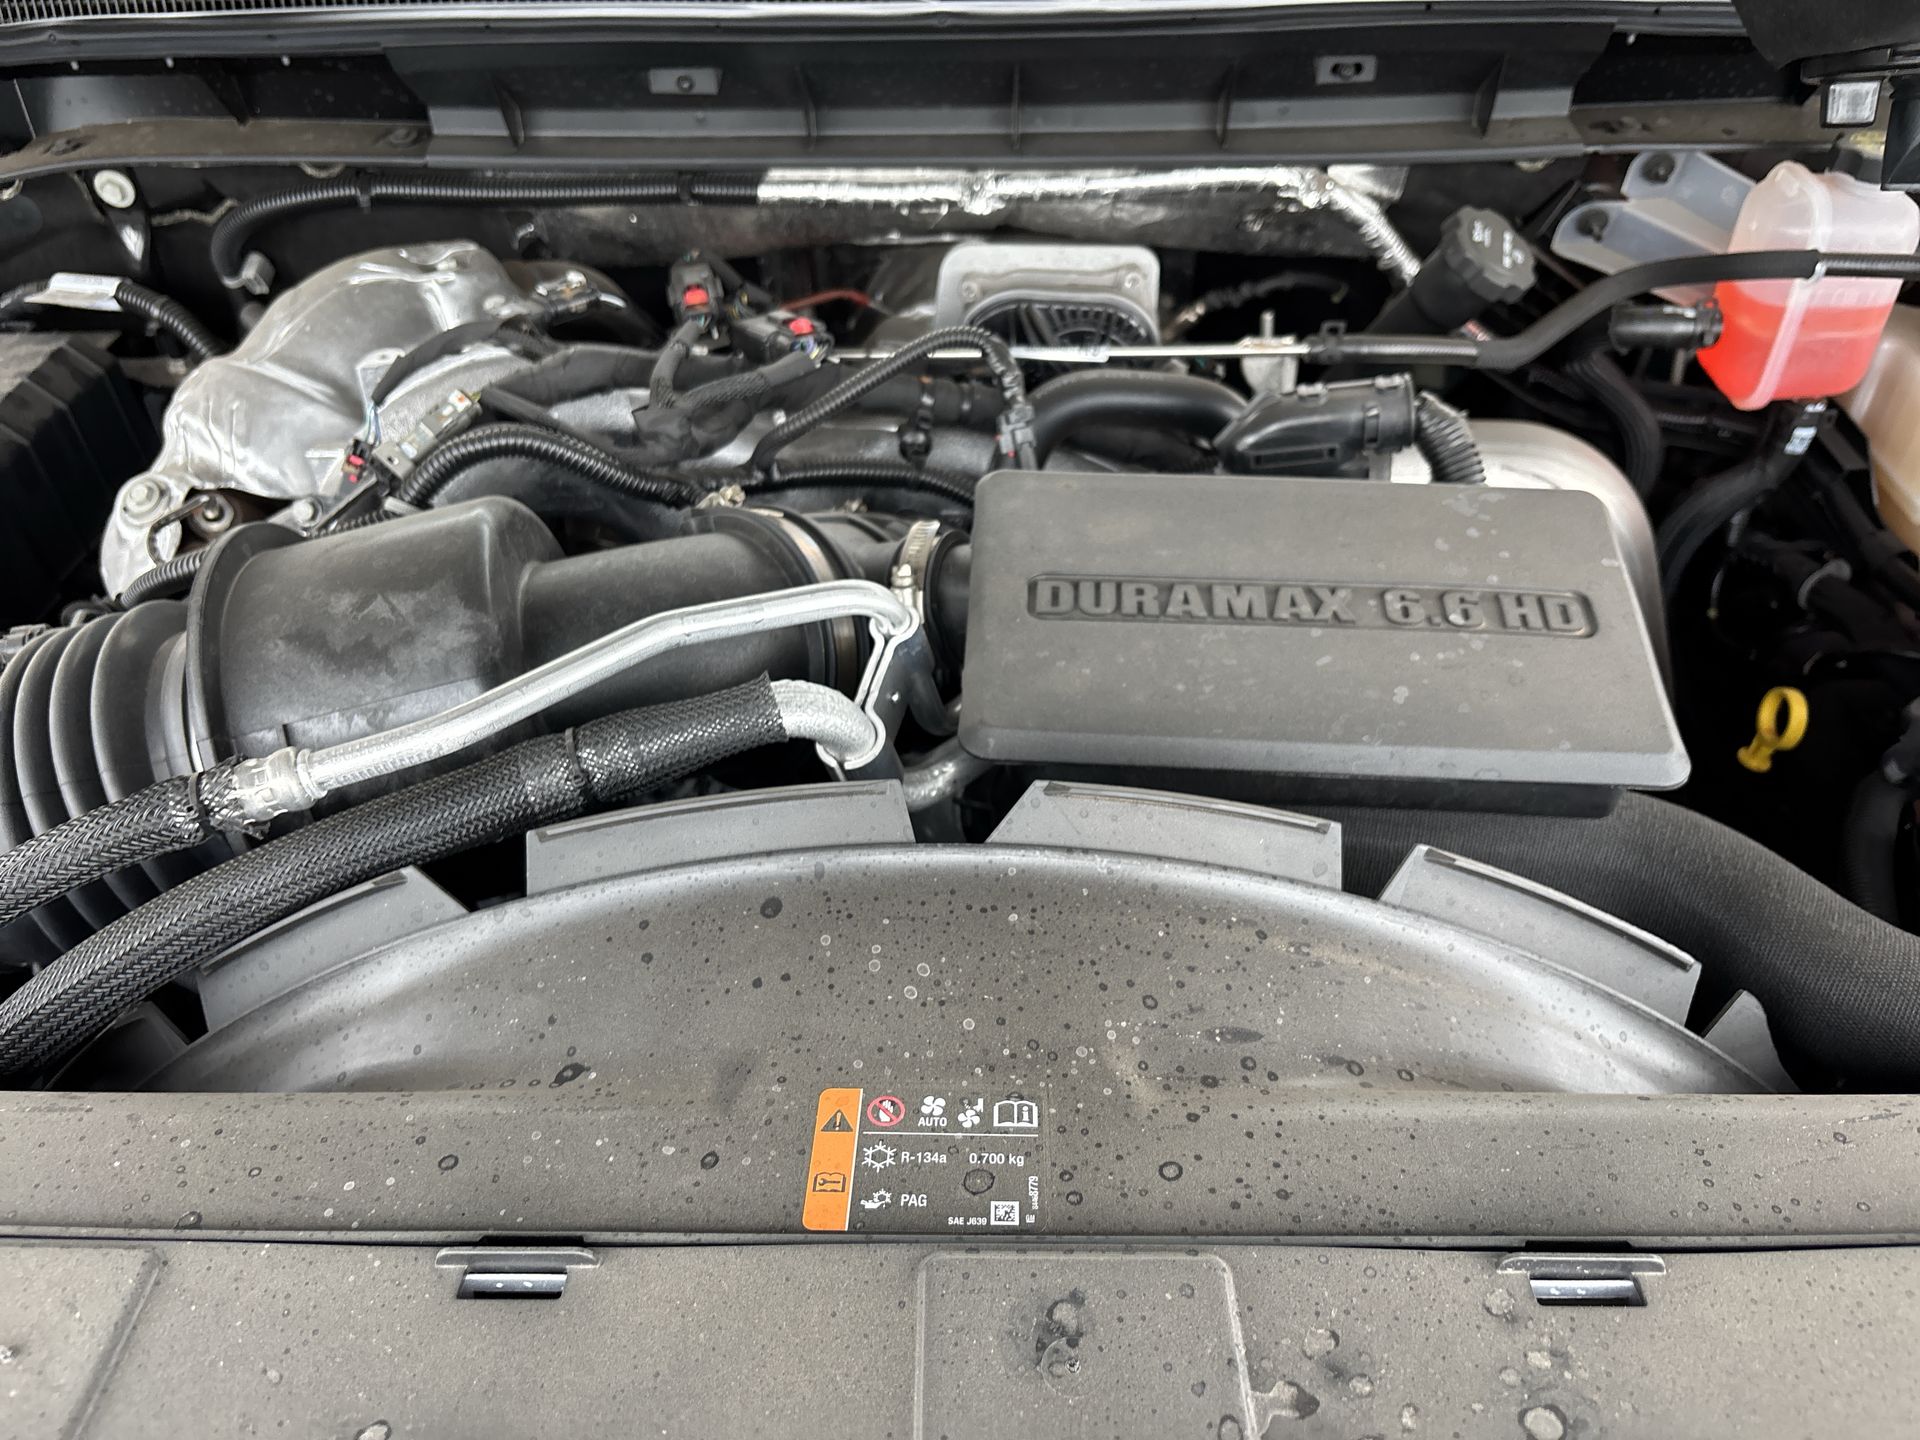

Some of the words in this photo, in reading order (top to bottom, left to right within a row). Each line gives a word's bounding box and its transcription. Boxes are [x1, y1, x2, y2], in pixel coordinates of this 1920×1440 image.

[1035, 580, 1356, 624] DURAMAX
[1382, 588, 1484, 628] 6.6
[1498, 592, 1588, 634] HD
[917, 1116, 948, 1127] AUTO
[901, 1151, 947, 1164] R-134a
[969, 1152, 1005, 1164] 0.700
[1008, 1153, 1025, 1167] kg
[900, 1193, 928, 1207] PAG
[947, 1216, 964, 1225] SAE
[966, 1217, 988, 1226] J639
